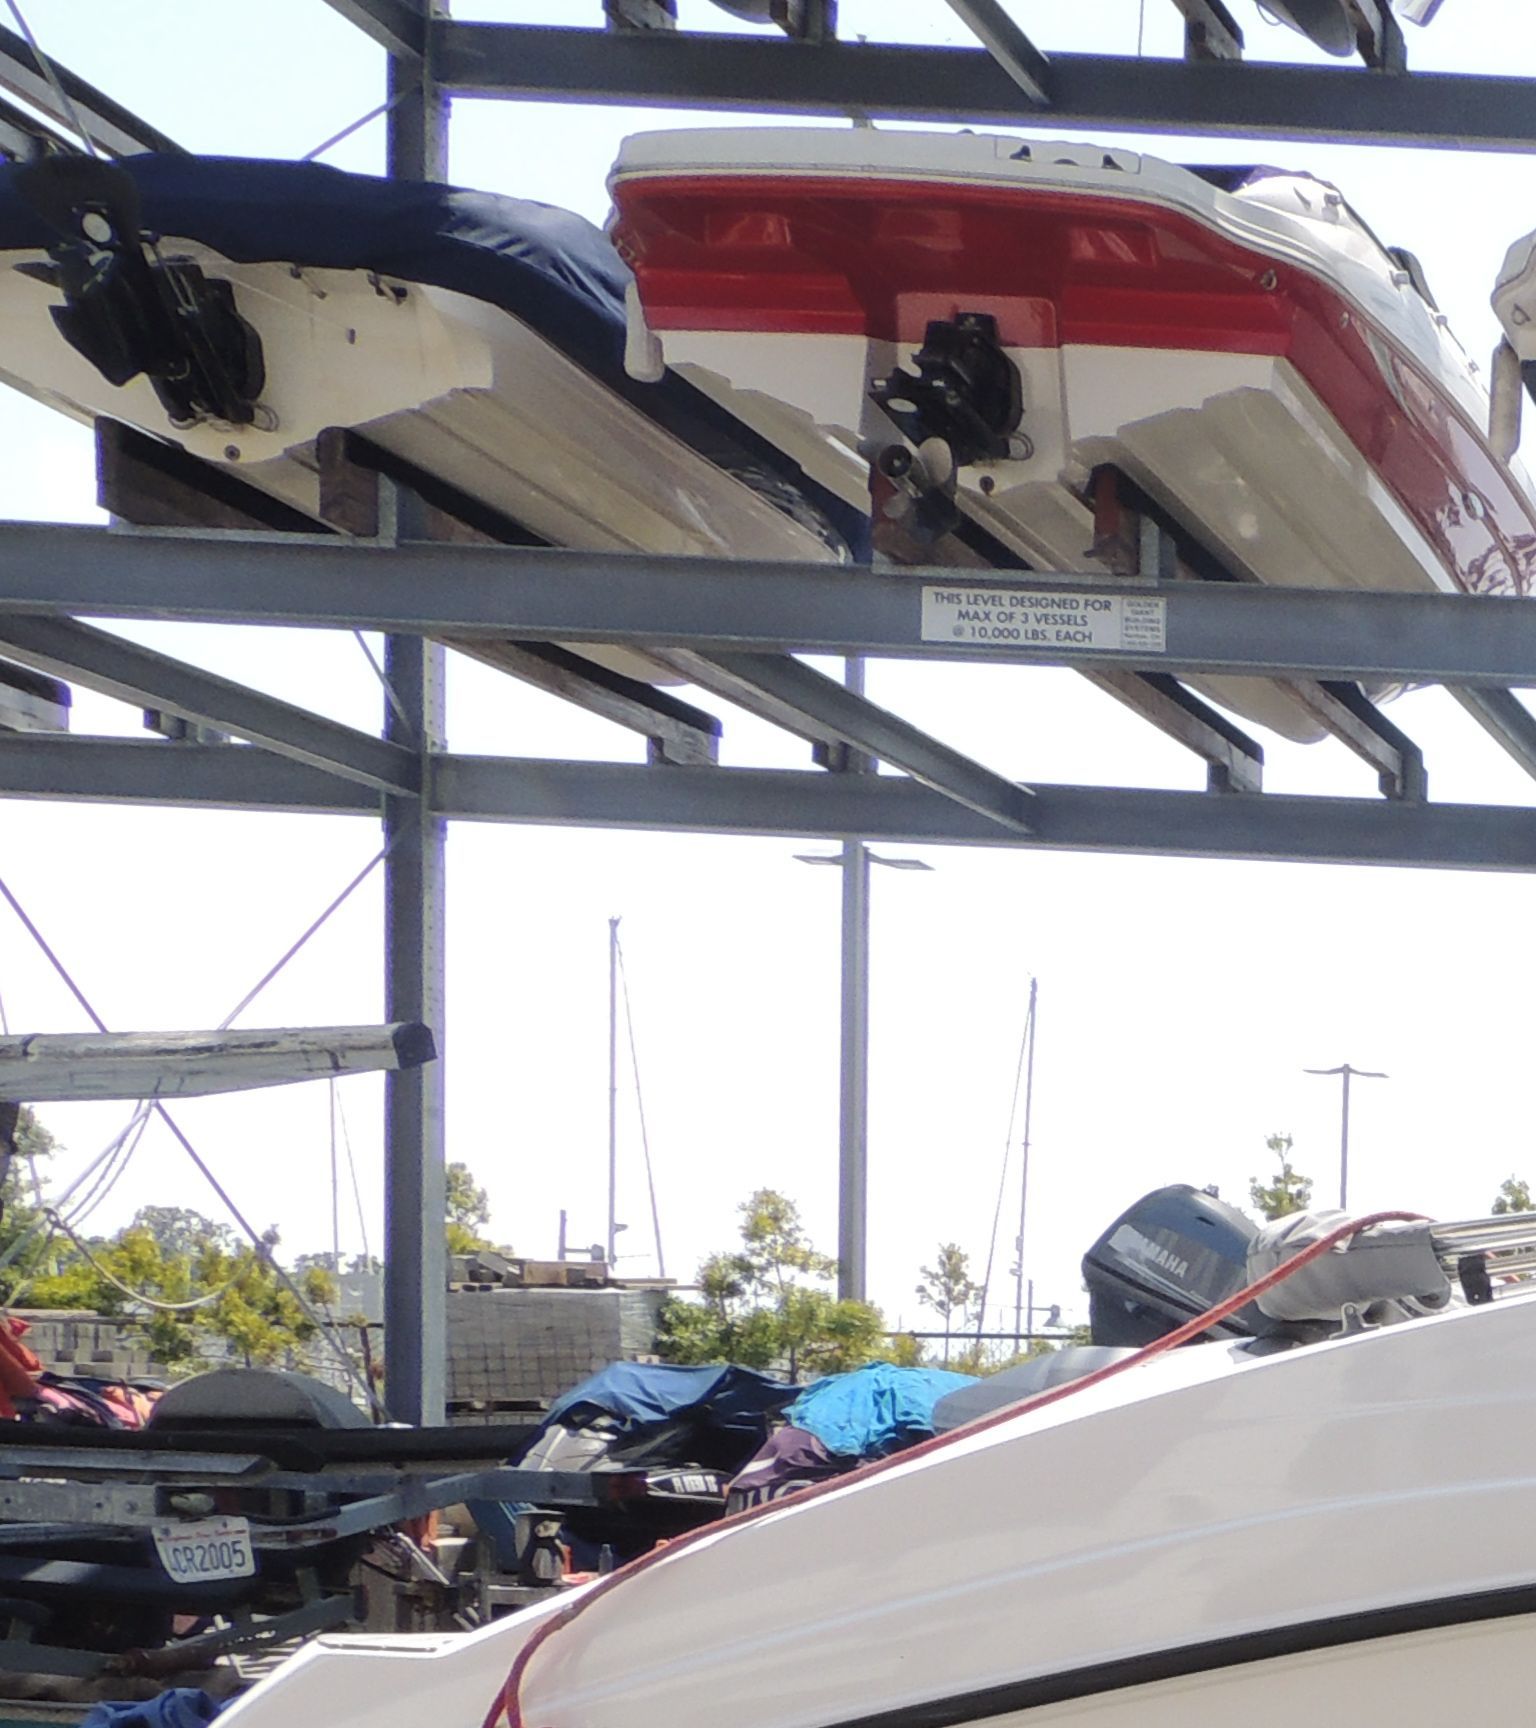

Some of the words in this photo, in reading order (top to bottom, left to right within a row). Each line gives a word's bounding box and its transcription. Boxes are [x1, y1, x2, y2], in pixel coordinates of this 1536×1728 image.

[934, 591, 962, 605] THIS
[967, 594, 1003, 607] LEVEL
[1010, 596, 1080, 610] DESIGNED
[1084, 599, 1112, 612] FOR
[957, 610, 991, 622] MAX
[997, 611, 1015, 623] OF
[1021, 613, 1029, 624] 3
[1036, 614, 1088, 627] VESSELS
[1056, 630, 1092, 643] EACH
